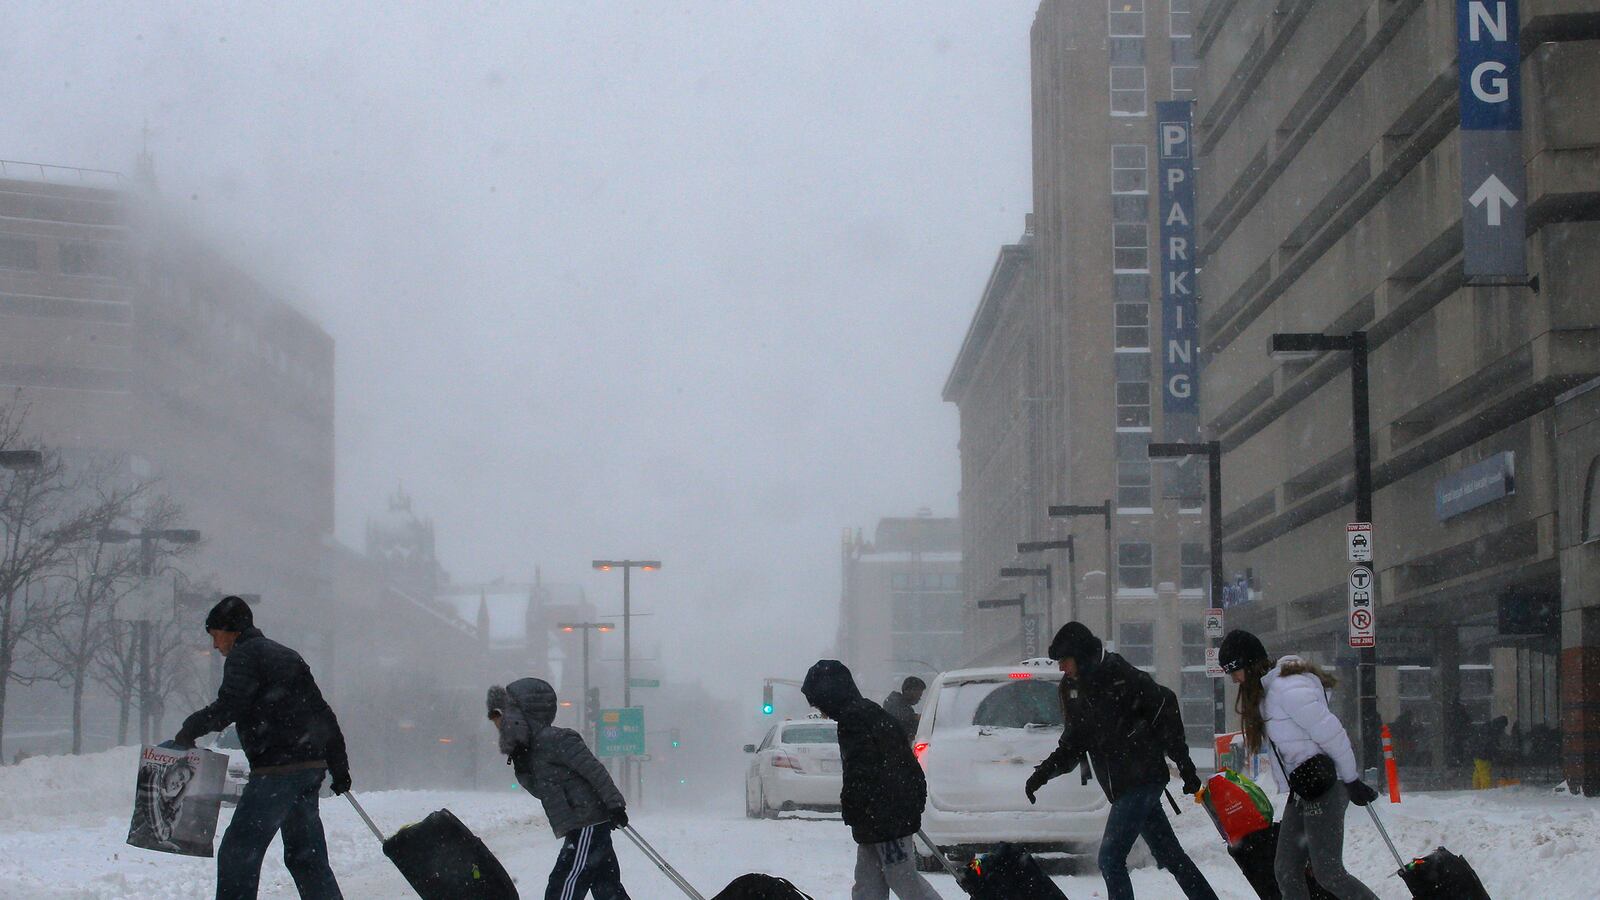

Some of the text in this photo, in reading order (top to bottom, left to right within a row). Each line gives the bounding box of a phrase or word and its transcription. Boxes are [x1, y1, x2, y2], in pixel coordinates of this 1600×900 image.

[1163, 125, 1186, 155] P
[1166, 168, 1191, 398] PARKING
[1353, 574, 1367, 586] T
[606, 729, 617, 738] 90
